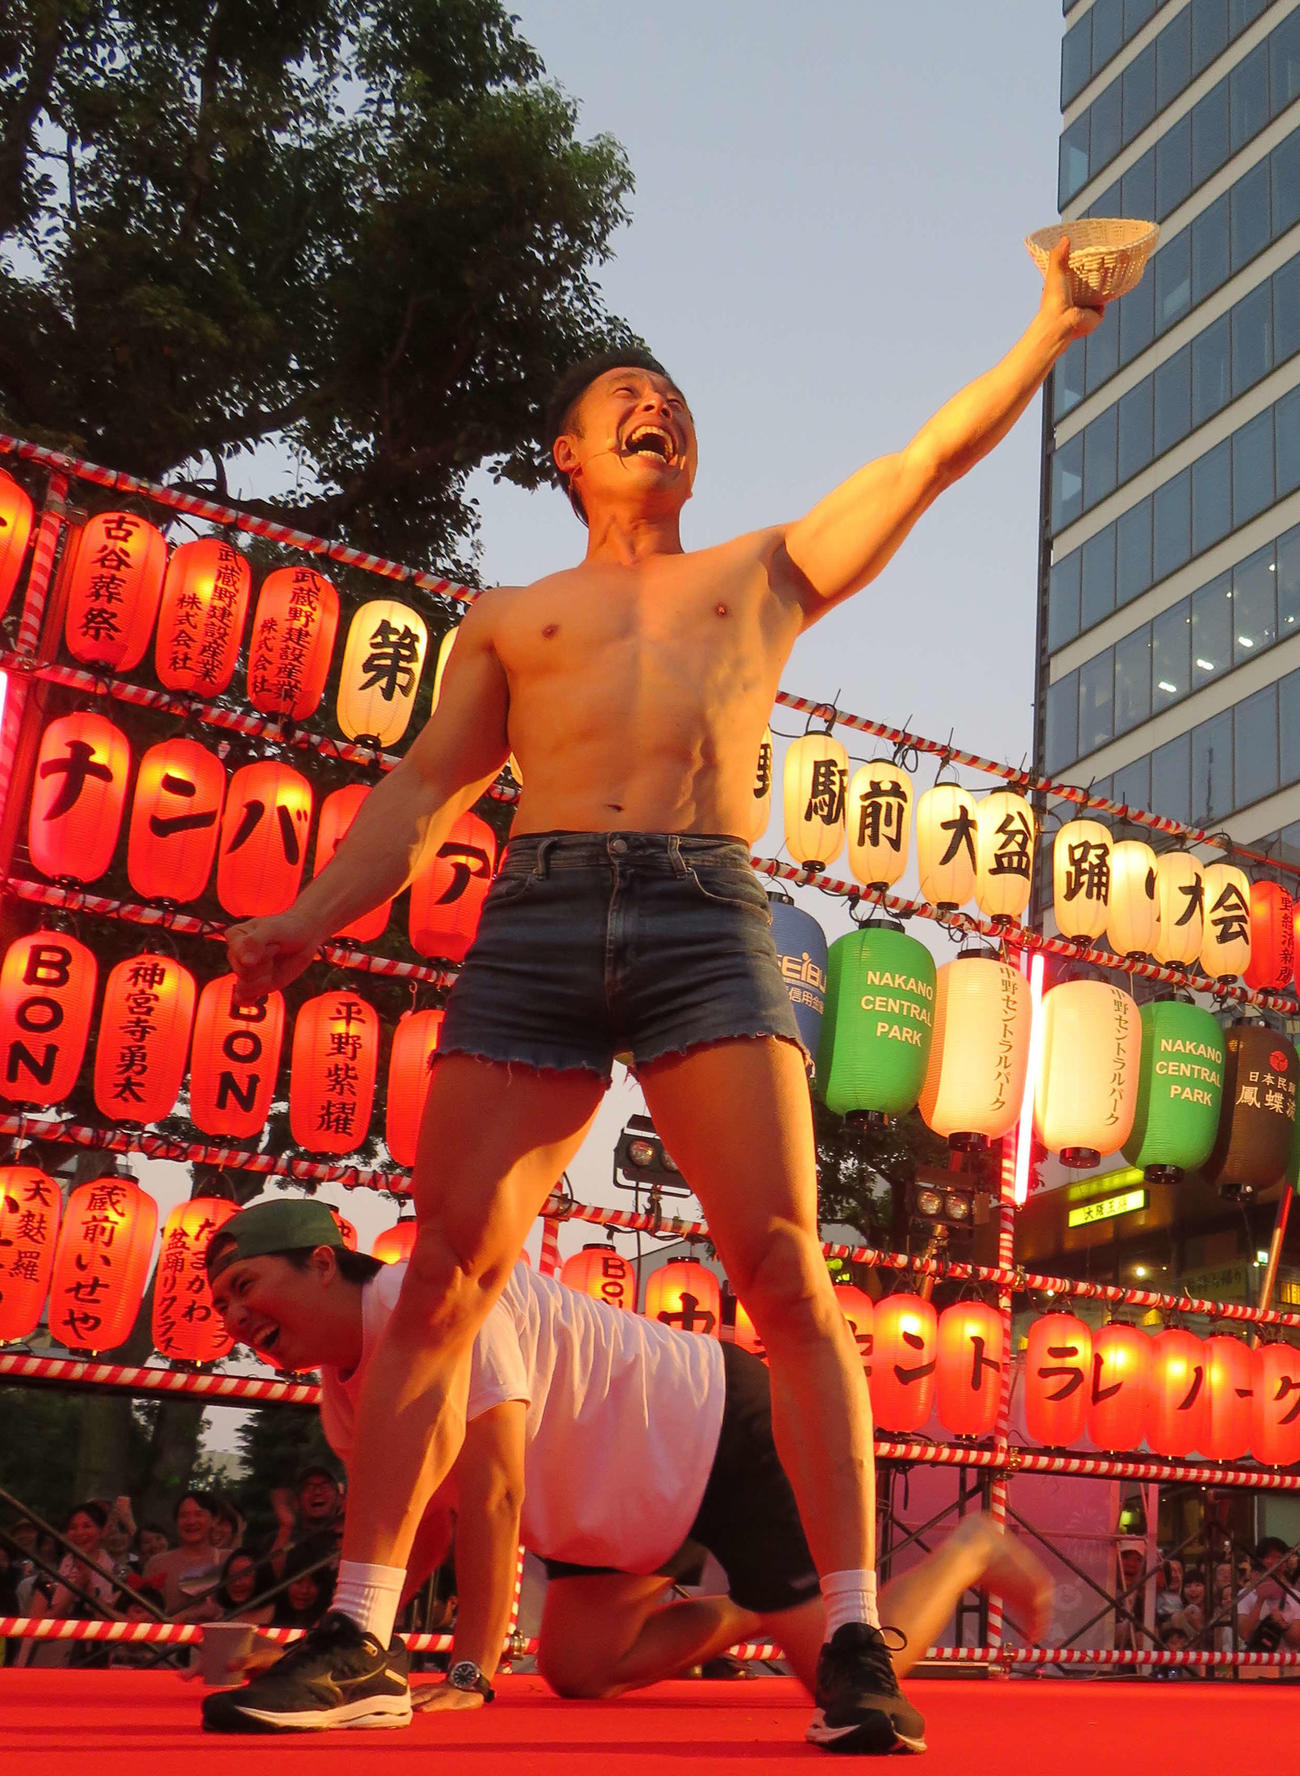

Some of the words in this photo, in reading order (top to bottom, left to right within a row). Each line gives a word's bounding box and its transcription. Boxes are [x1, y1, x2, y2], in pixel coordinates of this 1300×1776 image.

[80, 515, 140, 641] 古谷葬祭
[196, 544, 242, 685] 武蔵野建設産業
[168, 593, 202, 672] 株式会社
[252, 617, 278, 694] 株式会社
[273, 568, 320, 702] 武蔵野建設産業
[358, 619, 420, 702] 第
[39, 740, 114, 821] ナ
[150, 773, 218, 838] ン
[225, 800, 308, 866] バ
[434, 842, 492, 905] ア
[857, 780, 908, 852] 前
[988, 811, 1033, 881] 盆
[1063, 840, 1111, 907] 踊
[1209, 883, 1250, 945] 会
[6, 944, 73, 1085] BON
[111, 961, 166, 1103] 神宮寺勇太
[861, 995, 932, 1028] CENTRAL
[867, 970, 934, 1001] NAKANO
[876, 1021, 923, 1048] PARK
[315, 1001, 366, 1137] 平野紫耀
[989, 967, 1019, 1112] 中野セントラルパーク
[1105, 988, 1130, 1126] 中野セントラルパーク
[1155, 1061, 1221, 1088] CENTRAL
[1160, 1038, 1223, 1065] NAKANO
[1169, 1085, 1213, 1107] PARK
[9, 1179, 52, 1283] 天麩羅
[62, 1185, 128, 1341] 蔵前いせや
[601, 1256, 627, 1309] BO
